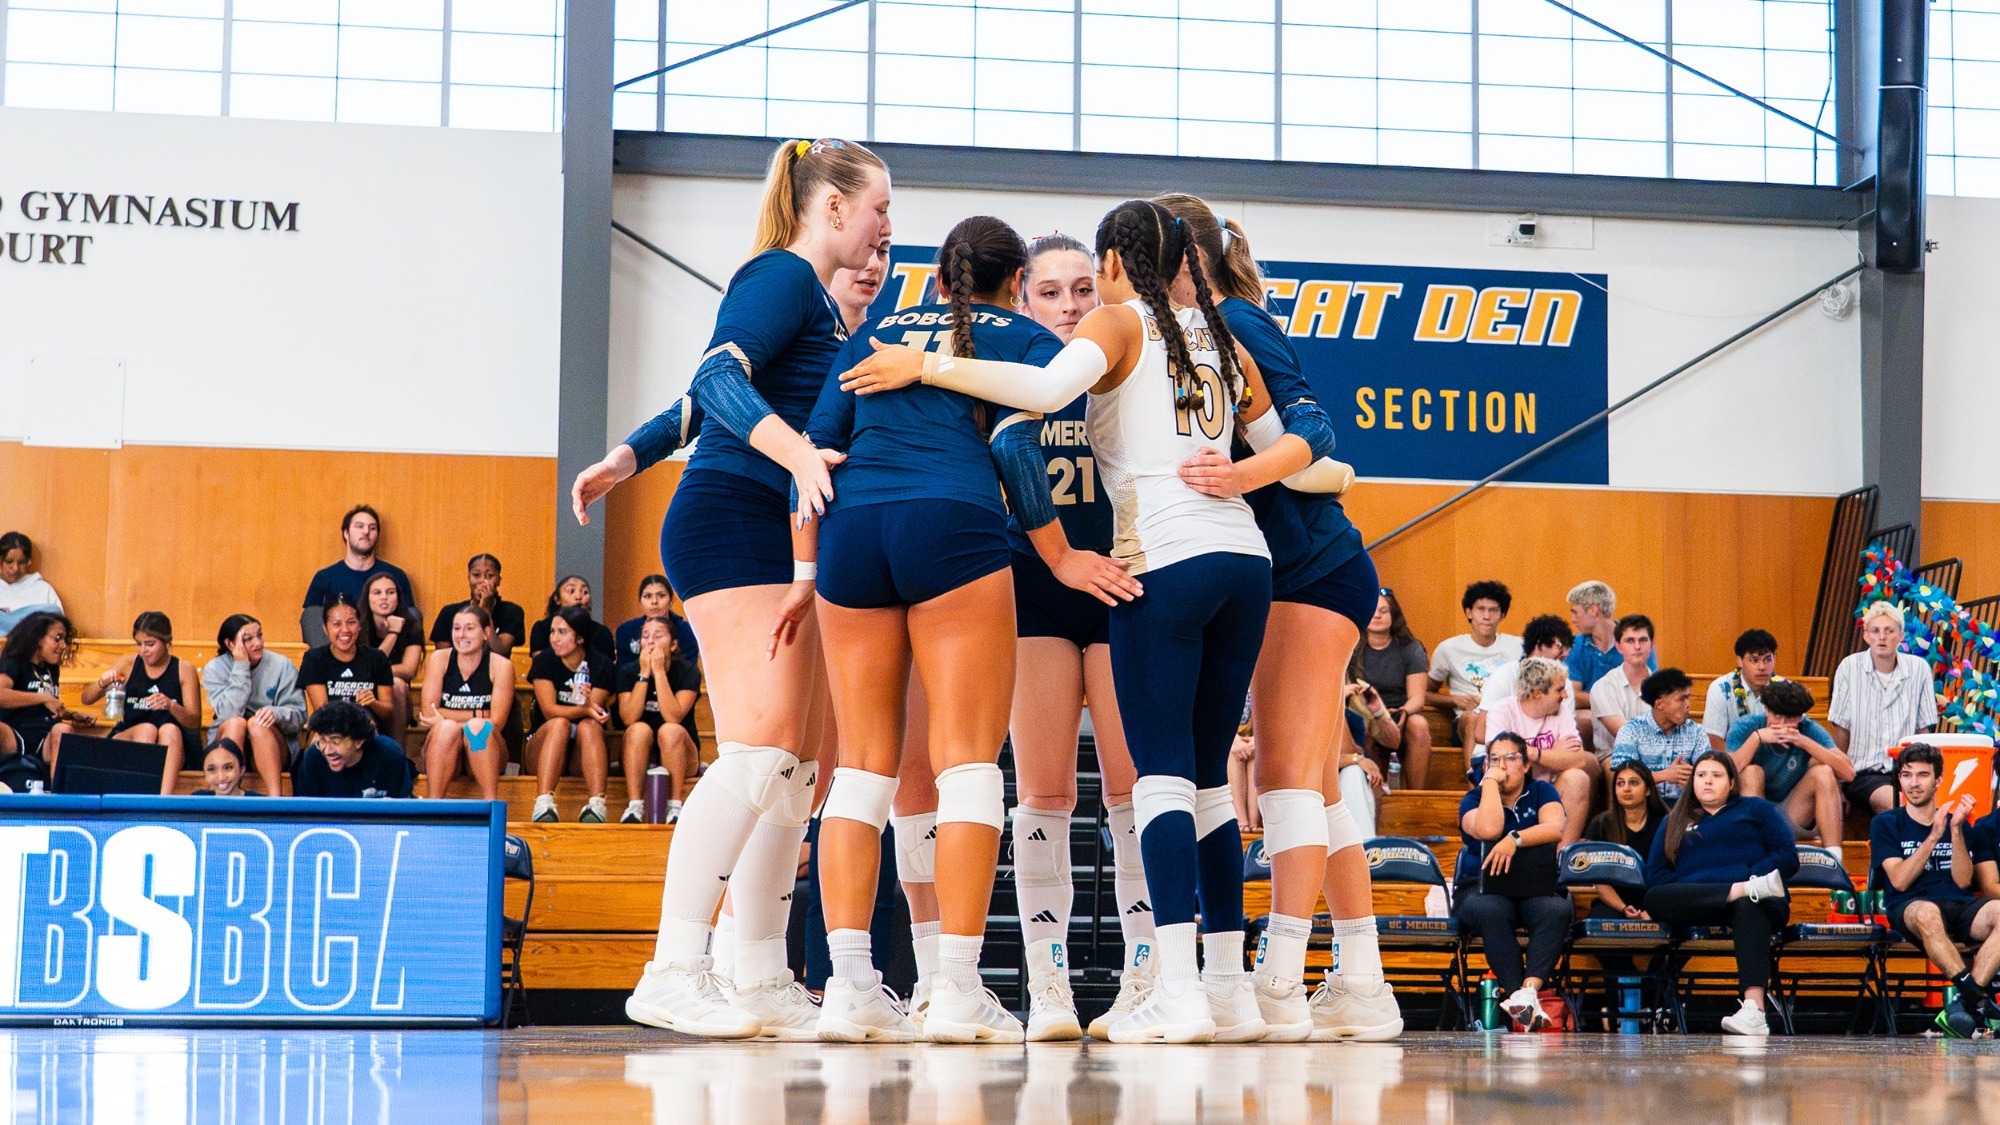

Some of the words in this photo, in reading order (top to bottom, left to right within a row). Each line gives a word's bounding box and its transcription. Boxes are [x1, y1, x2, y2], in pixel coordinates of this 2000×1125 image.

[20, 190, 300, 231] GYMNASIUM
[0, 232, 93, 265] URT
[1413, 284, 1583, 347] DEN
[1167, 363, 1225, 440] 10
[1356, 387, 1536, 434] SECTION
[1047, 456, 1096, 506] 21
[1903, 848, 1953, 857] ATTICS
[1388, 921, 1402, 929] UC
[1406, 921, 1447, 930] MERCED
[1619, 923, 1659, 932] MERCED
[53, 1017, 124, 1026] DAKTRONICS
